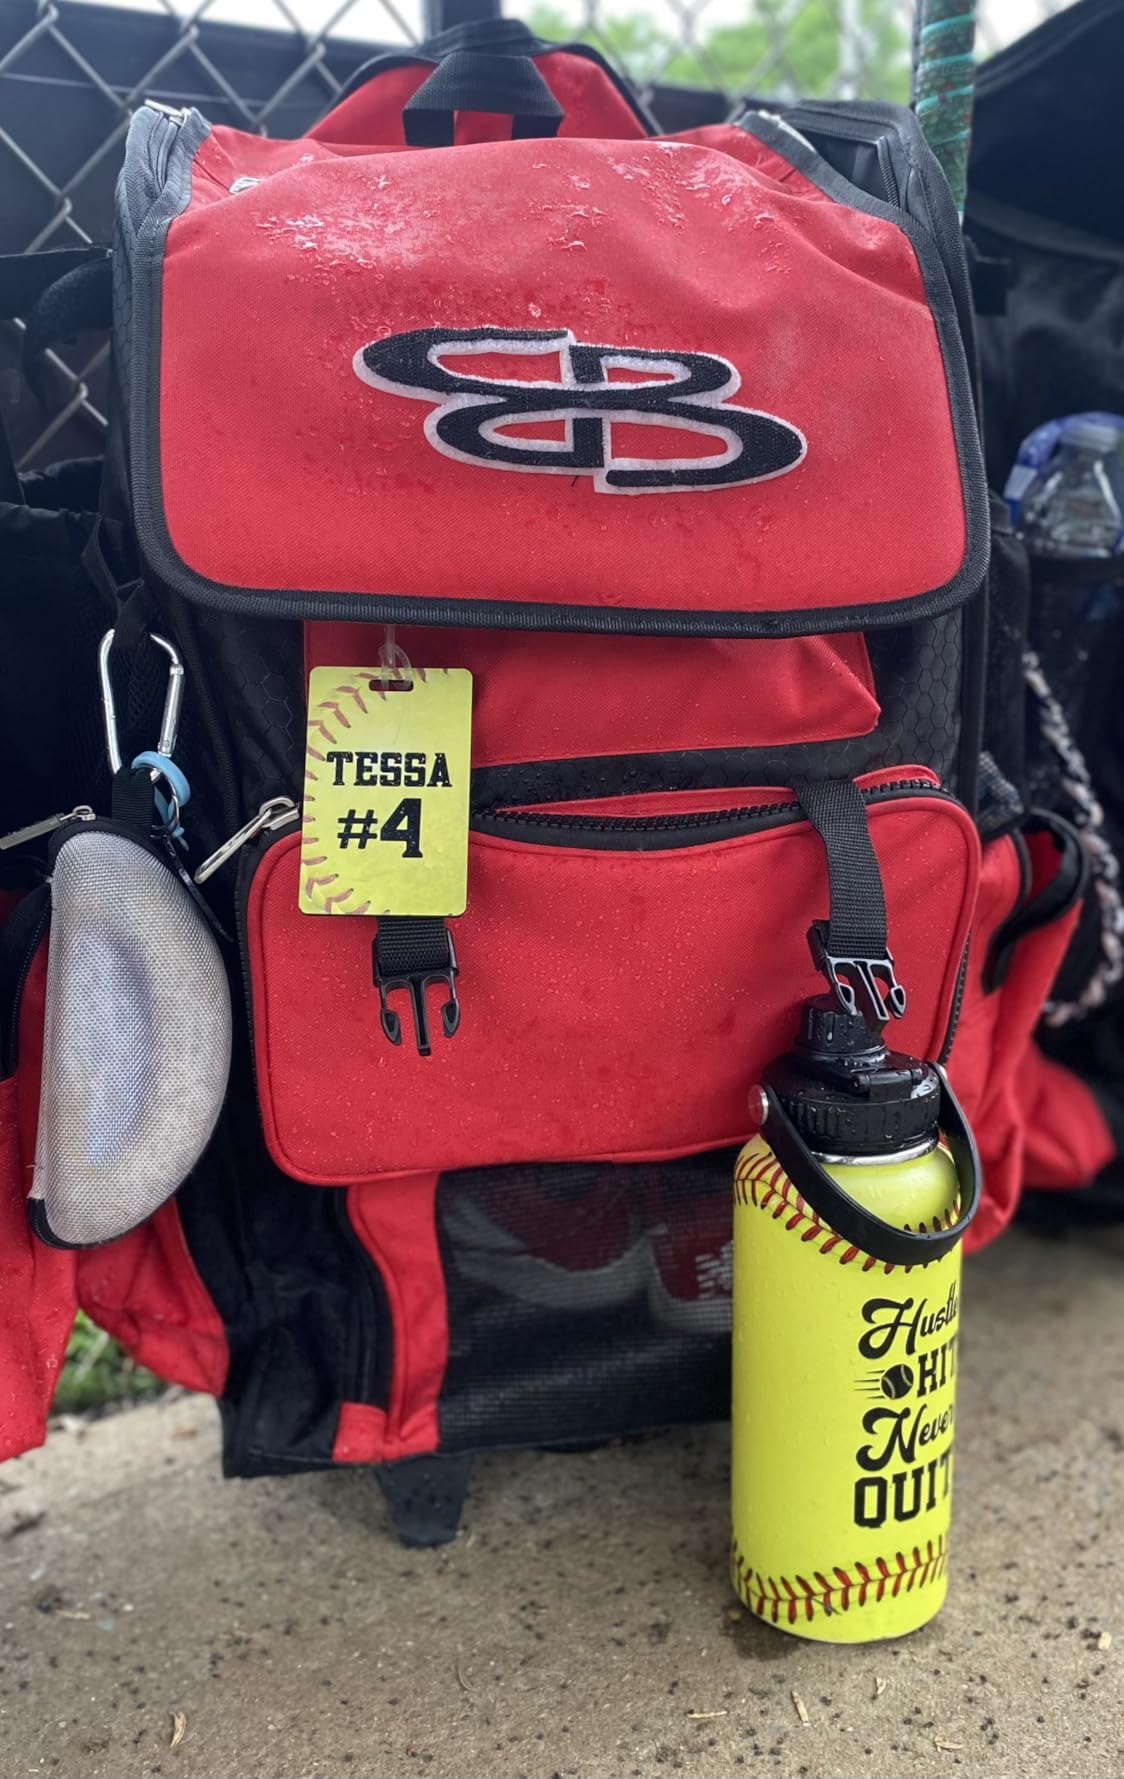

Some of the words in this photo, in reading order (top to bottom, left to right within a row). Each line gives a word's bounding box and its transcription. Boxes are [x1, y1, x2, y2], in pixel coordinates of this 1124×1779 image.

[326, 751, 453, 788] TESSA
[336, 798, 424, 859] #4
[917, 1336, 957, 1398] HIT
[853, 1448, 950, 1529] QUIT
